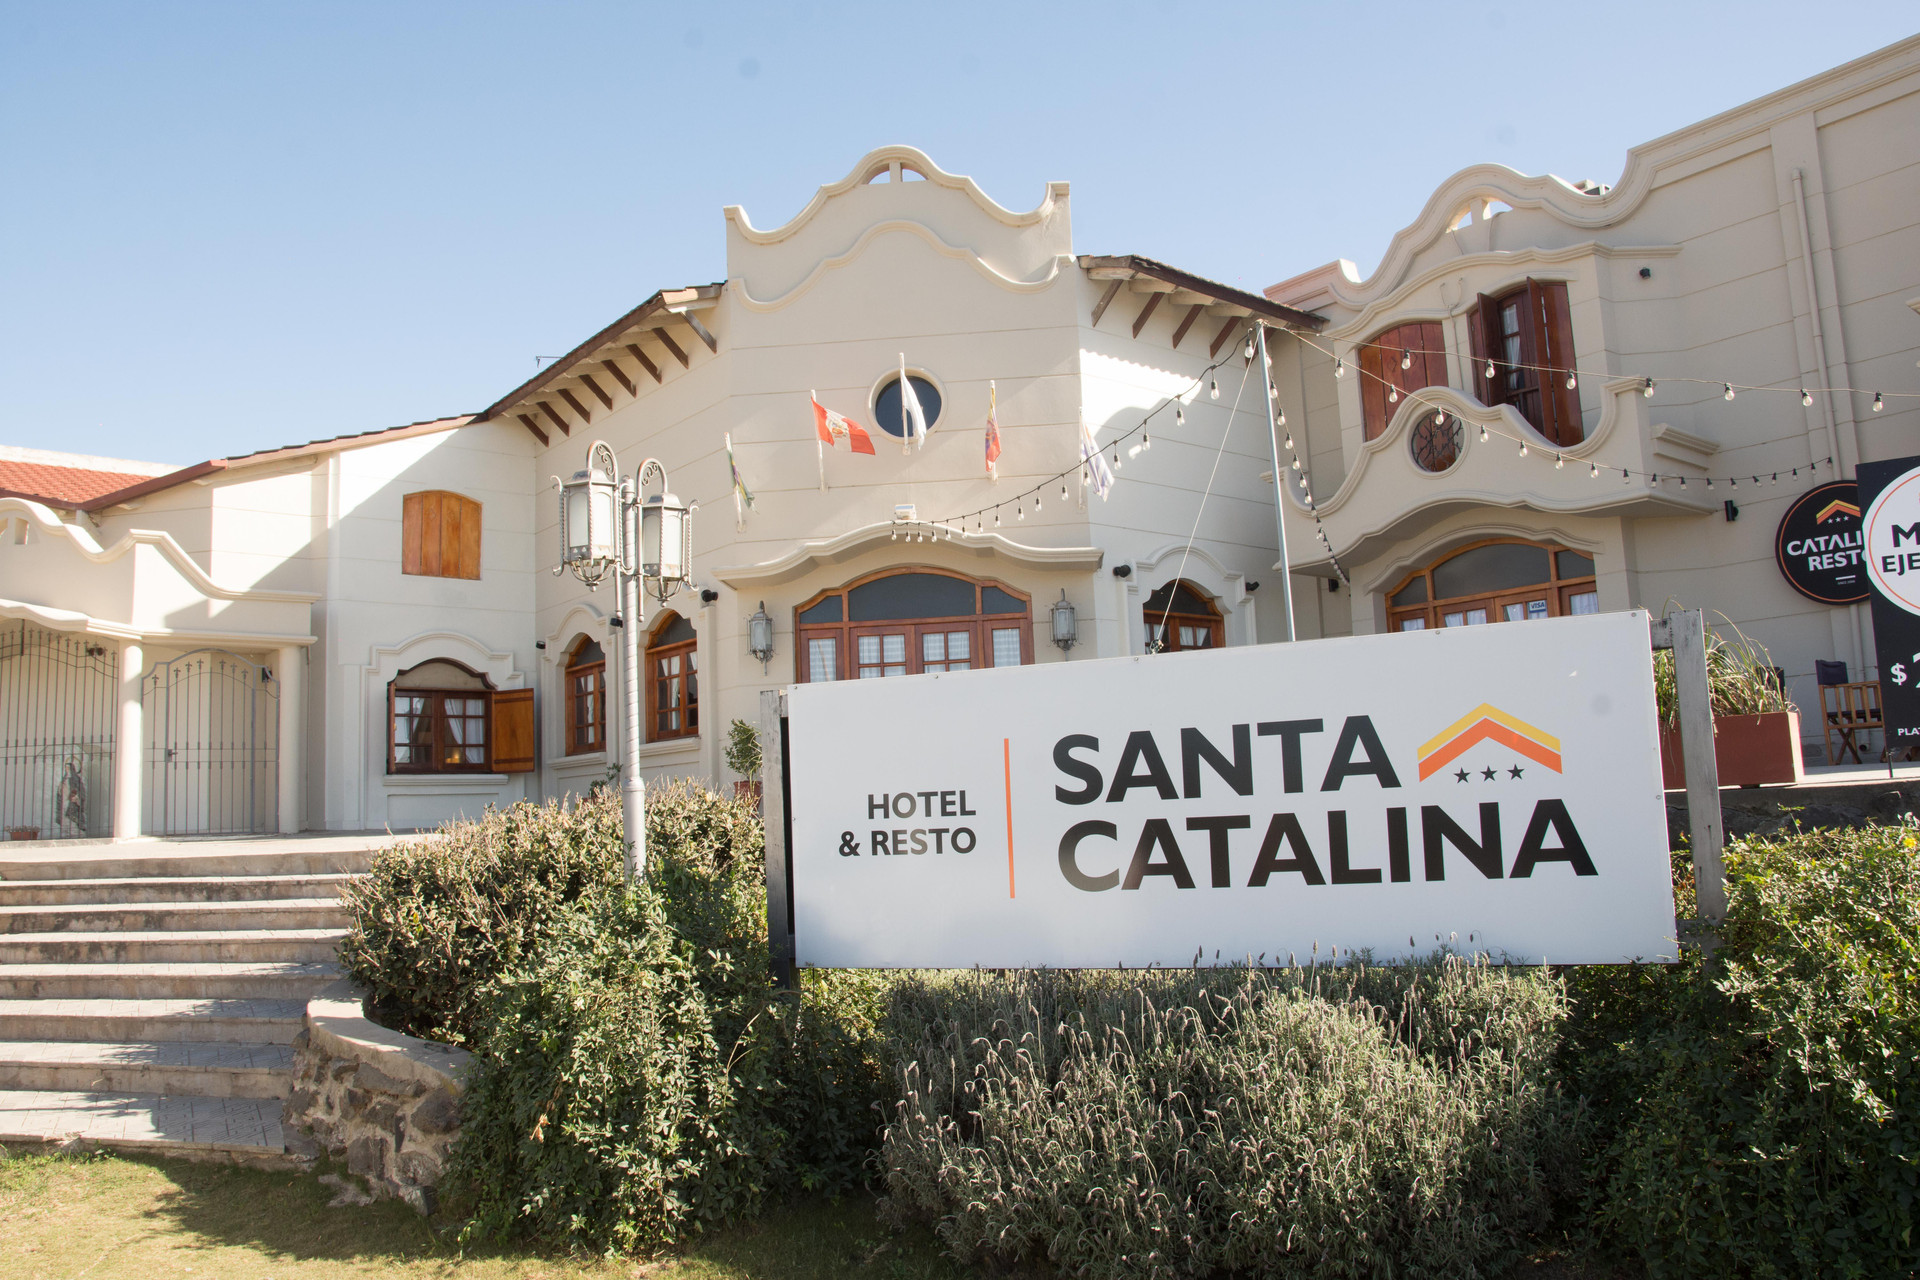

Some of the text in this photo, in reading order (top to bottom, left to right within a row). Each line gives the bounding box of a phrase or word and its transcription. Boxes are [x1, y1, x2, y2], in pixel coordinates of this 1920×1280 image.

[1531, 601, 1545, 609] VISA
[1052, 715, 1402, 805] SANTA
[867, 790, 977, 820] HOTEL
[838, 827, 977, 857] & RESTO
[1057, 798, 1599, 892] CATALINA
